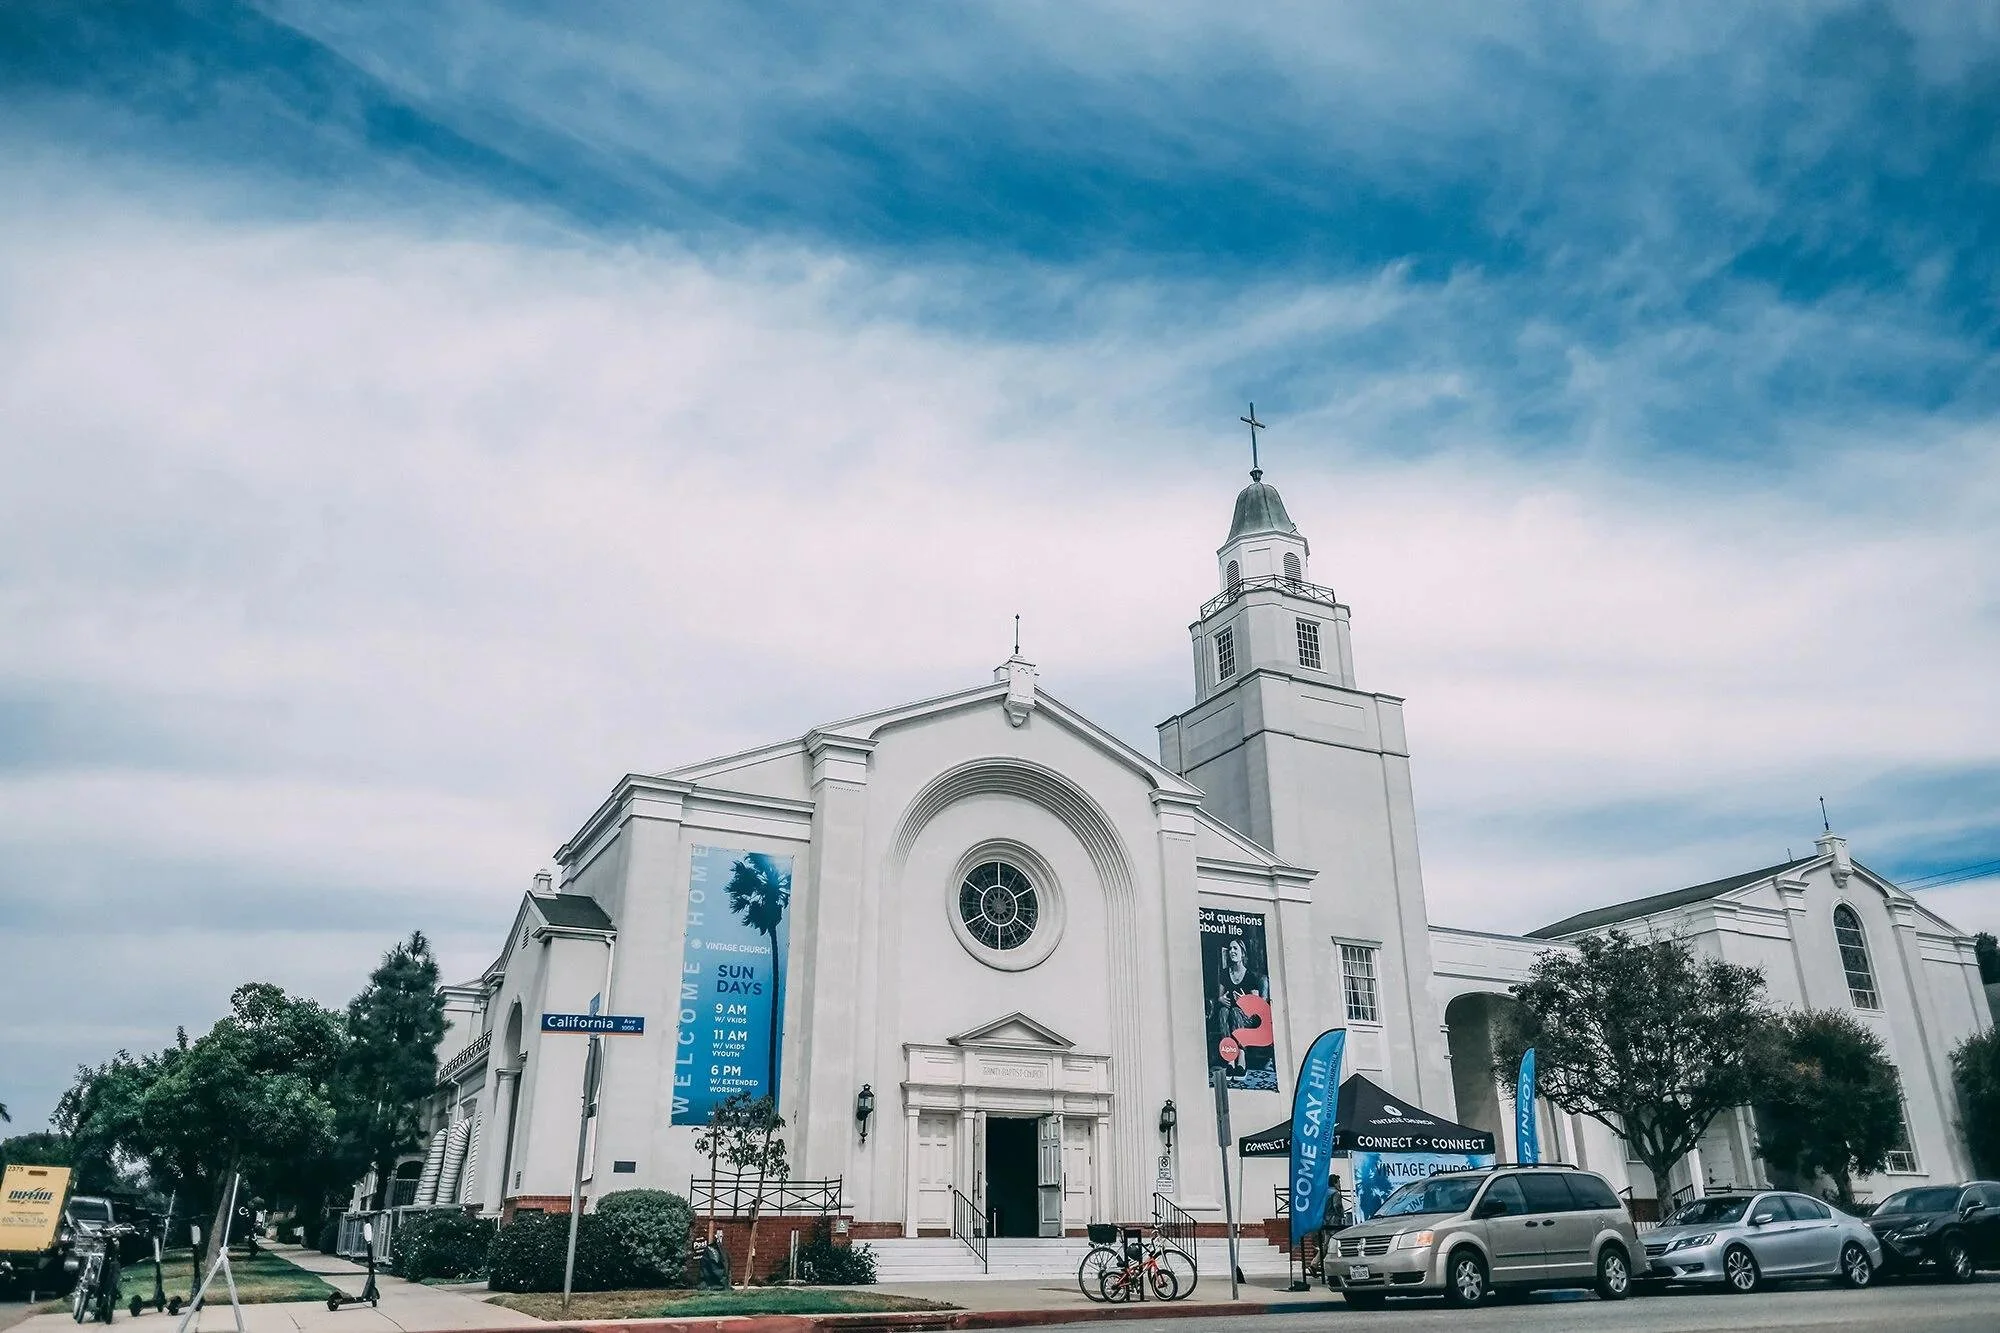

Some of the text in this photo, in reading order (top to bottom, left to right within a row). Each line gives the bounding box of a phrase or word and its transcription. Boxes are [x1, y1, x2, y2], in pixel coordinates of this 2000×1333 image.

[1199, 910, 1262, 926] Got questions
[1199, 922, 1243, 936] about life
[705, 941, 771, 954] VINTAGE CHURCH
[718, 964, 754, 979] SUN
[671, 846, 708, 1115] WELCOME HOME
[716, 979, 762, 995] DAYS
[715, 1003, 747, 1015] 9 AM
[547, 1016, 614, 1029] California
[713, 1030, 748, 1041] 11 AM
[711, 1050, 740, 1058] VYOUTH
[711, 1065, 741, 1076] 6 PM
[1522, 1073, 1531, 1136] INFO?
[1295, 1058, 1327, 1212] COME SAY HI!
[1245, 1138, 1285, 1152] CONNECT
[1357, 1135, 1412, 1148] CONNECT
[1431, 1138, 1485, 1150] CONNECT
